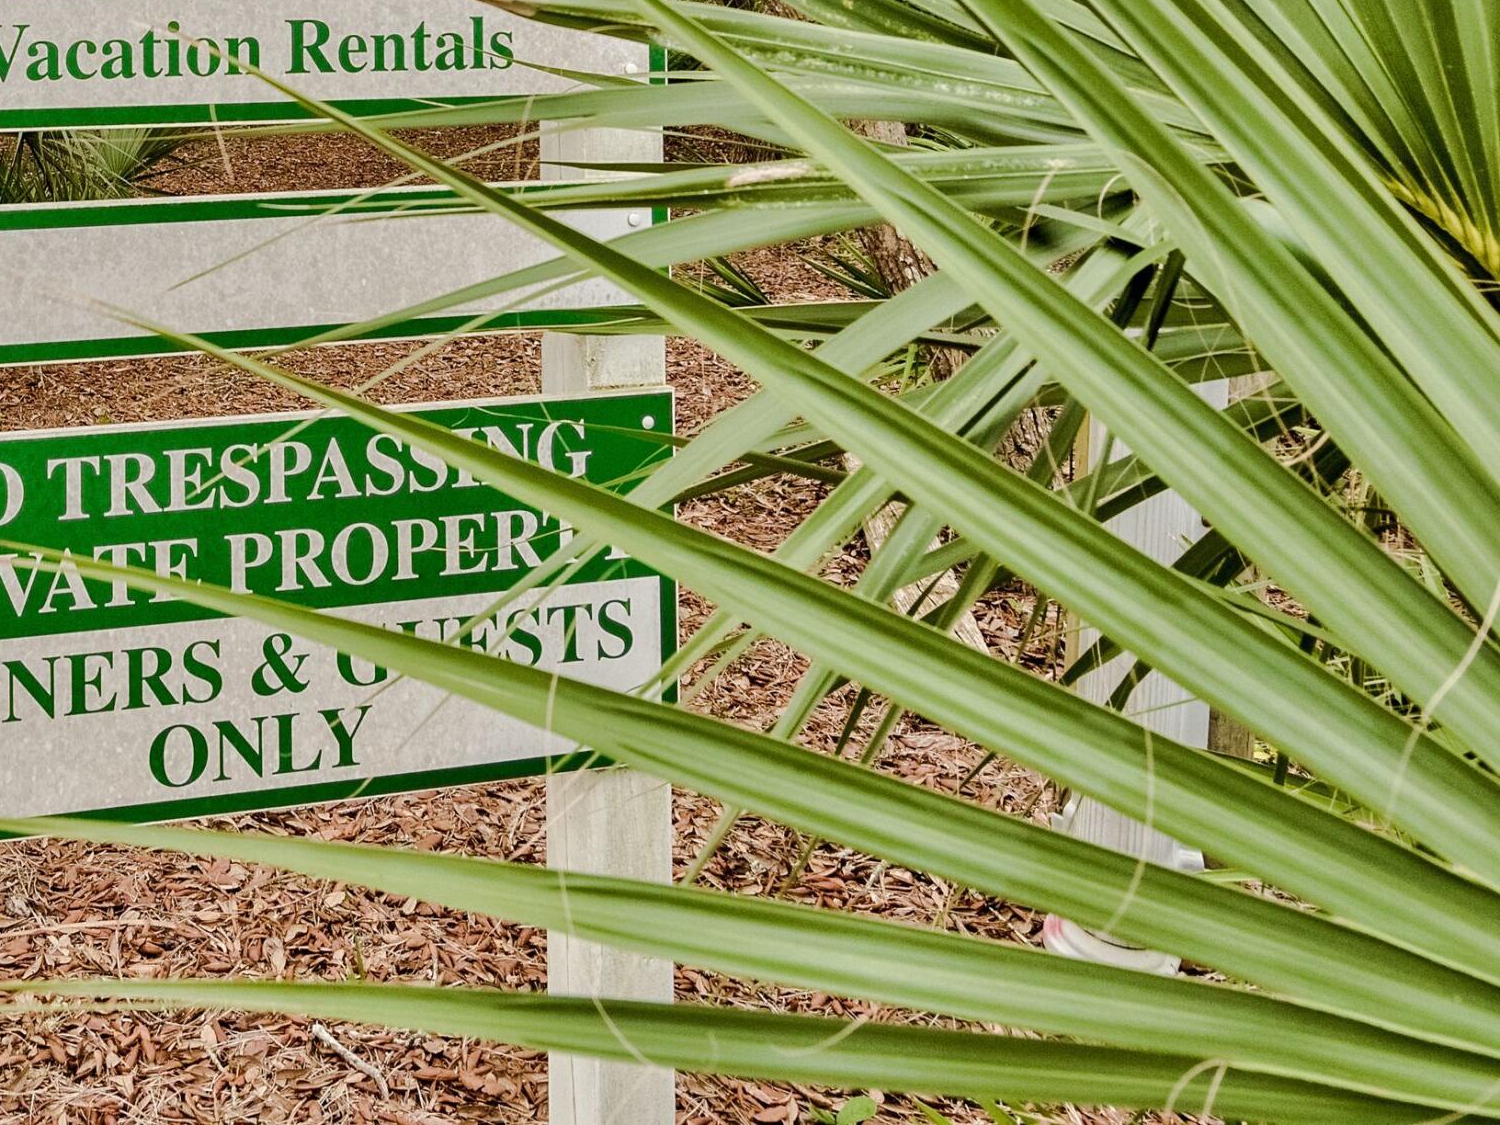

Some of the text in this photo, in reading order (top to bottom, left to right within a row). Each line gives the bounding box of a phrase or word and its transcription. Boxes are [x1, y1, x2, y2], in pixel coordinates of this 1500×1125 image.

[285, 16, 515, 74] Rentals
[47, 419, 592, 521] TRESPASSING
[224, 501, 638, 594] PROPER
[250, 632, 311, 697] &
[148, 704, 373, 789] ONLY
